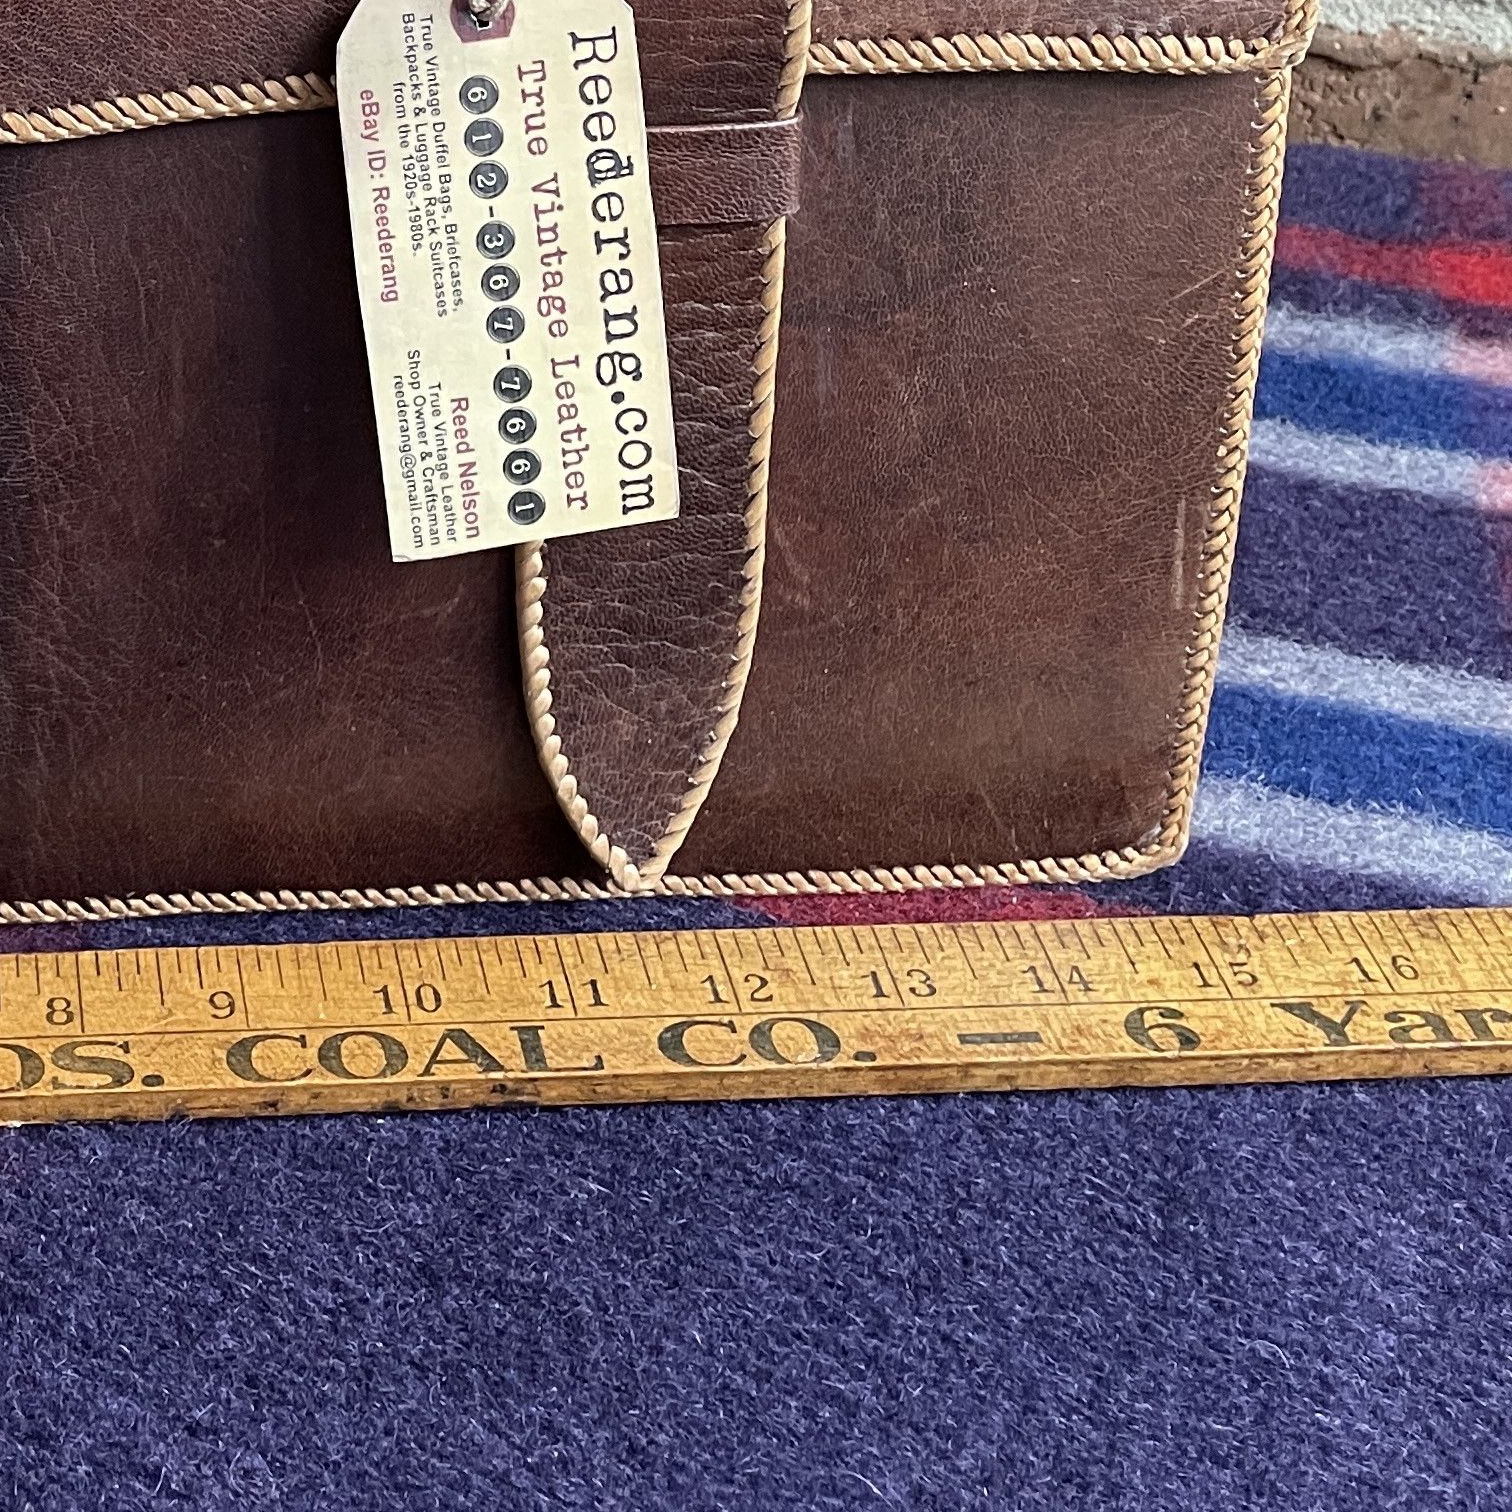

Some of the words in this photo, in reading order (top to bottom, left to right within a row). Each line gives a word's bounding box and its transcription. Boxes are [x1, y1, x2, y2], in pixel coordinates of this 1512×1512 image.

[420, 13, 434, 51] True
[402, 13, 423, 101] Backpacks
[393, 81, 406, 119] from
[425, 55, 441, 116] Vintage
[518, 60, 548, 156] True
[360, 89, 380, 142] eBay
[414, 106, 426, 117] &
[398, 124, 410, 149] the
[414, 122, 432, 191] Luggage
[432, 121, 450, 168] Duffel
[367, 150, 387, 179] ID:
[402, 154, 424, 257] 1920s-1980s.
[424, 196, 440, 236] Rack
[438, 173, 453, 219] Bags,
[372, 187, 399, 303] Reederang
[444, 223, 464, 312] Briefcases,
[531, 172, 568, 338] Vintage
[430, 241, 448, 317] Suitcases
[568, 25, 655, 516] Reederang.com
[407, 349, 421, 390] Shop
[413, 395, 428, 446] Owner
[428, 381, 441, 417] True
[450, 396, 475, 454] Reed
[550, 354, 590, 512] Leather
[393, 375, 423, 548] reederang@gmail.com
[420, 451, 433, 462] &
[434, 421, 449, 480] Vintage
[422, 467, 440, 546] Craftsman
[441, 485, 457, 543] Leather
[458, 461, 480, 539] Nelson
[539, 978, 610, 1009] 11
[700, 972, 775, 1004] 12
[861, 968, 938, 999] 13
[1020, 963, 1098, 994] 14
[1192, 960, 1258, 988] 15
[1344, 954, 1420, 984] 16
[45, 996, 75, 1027] 8
[208, 990, 236, 1020] 9
[373, 982, 443, 1015] 10
[226, 1025, 605, 1083] COAL
[656, 1016, 878, 1067] CO.
[1123, 1006, 1202, 1053] 6
